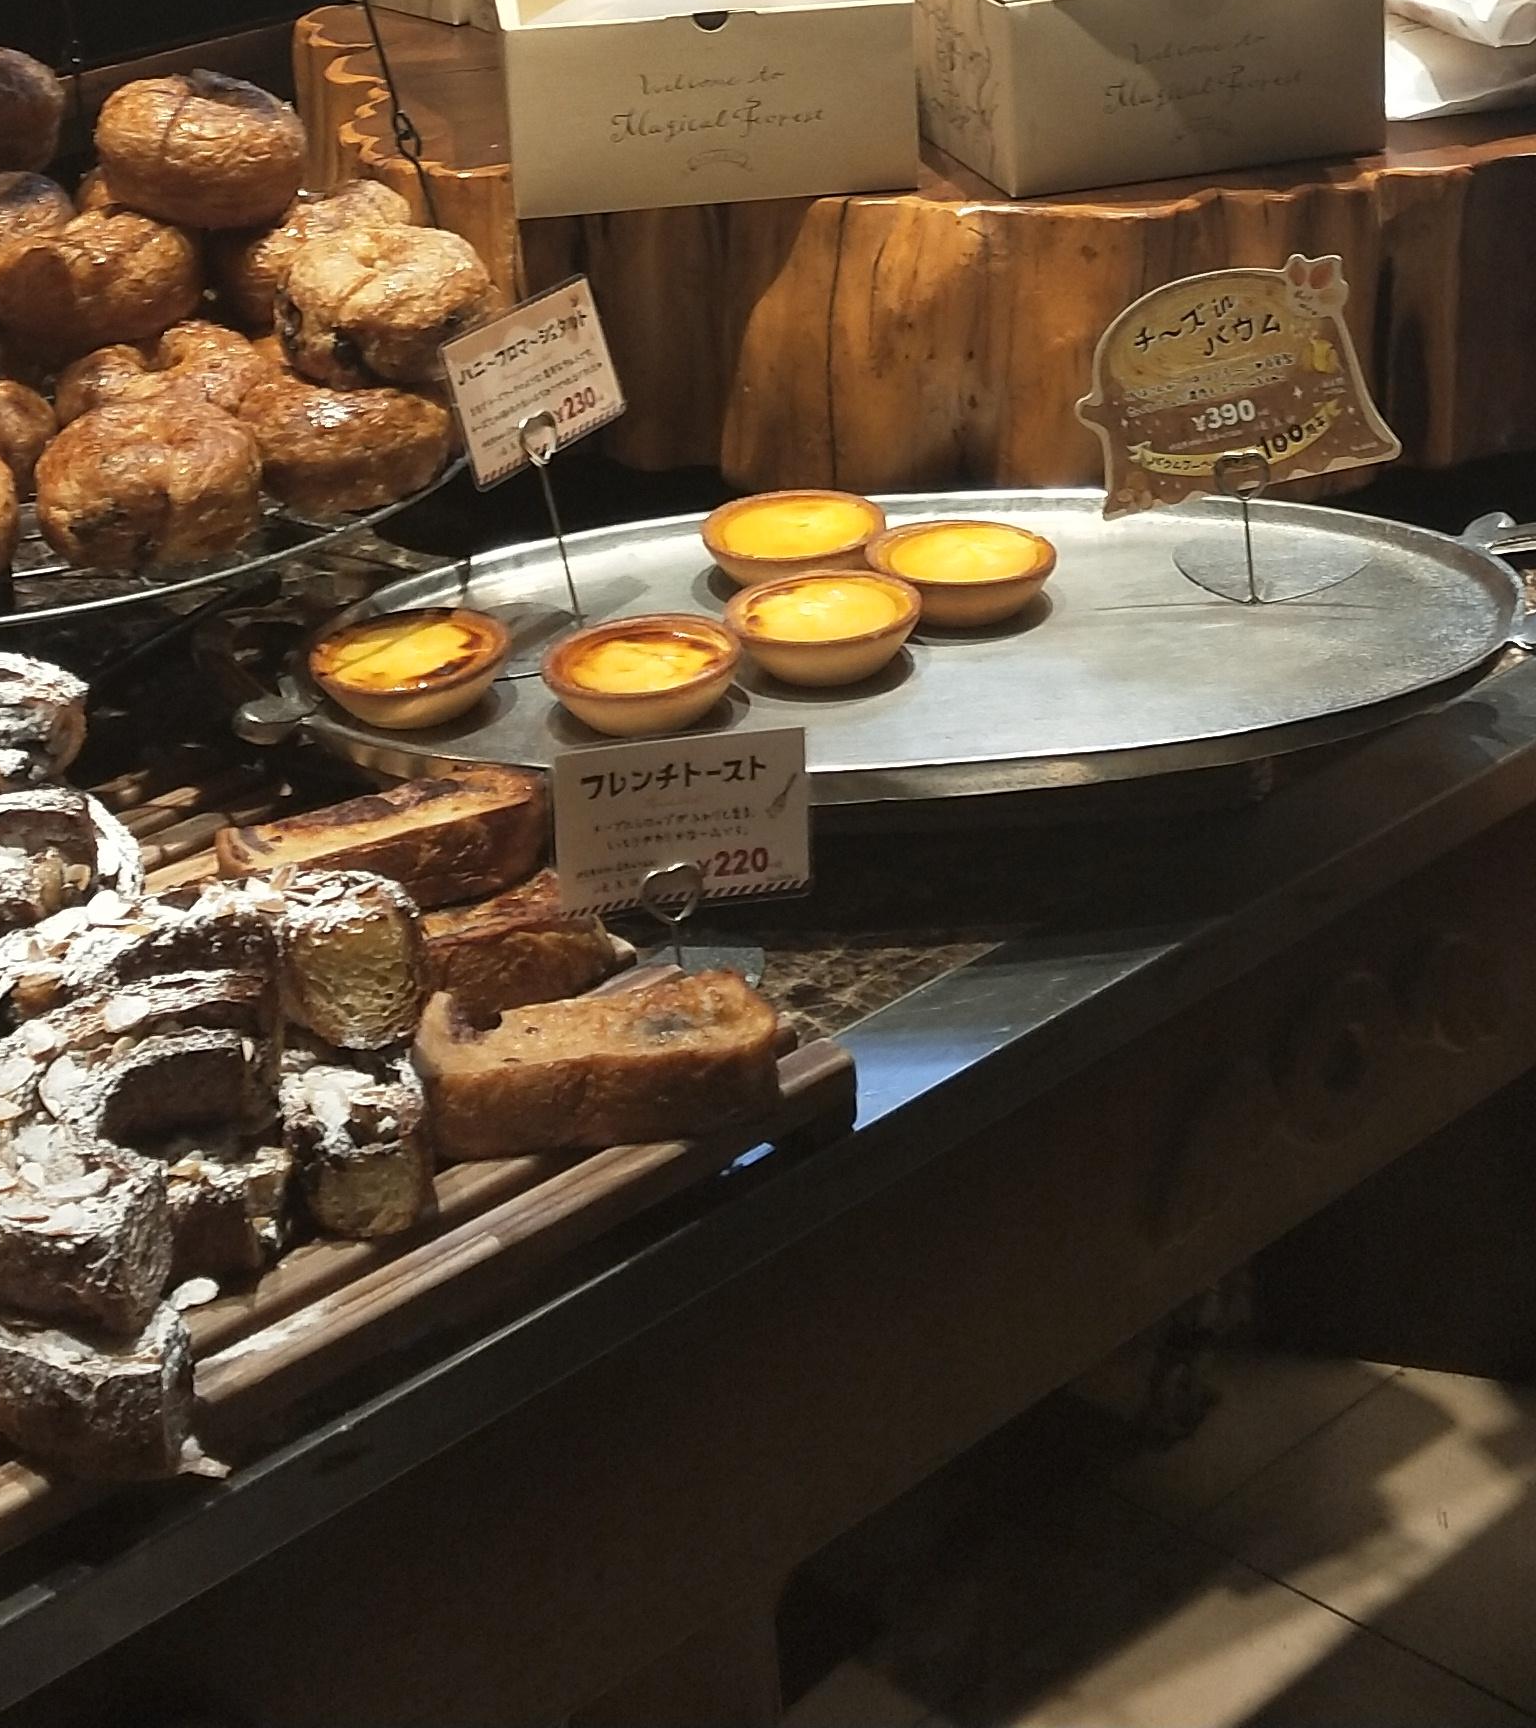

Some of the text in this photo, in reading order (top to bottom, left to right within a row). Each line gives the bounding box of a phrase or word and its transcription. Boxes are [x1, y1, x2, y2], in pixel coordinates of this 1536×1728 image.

[1203, 313, 1281, 357] バウム
[1191, 400, 1256, 433] ¥390
[580, 755, 767, 800] フレンチトースト
[696, 846, 769, 879] ¥220
